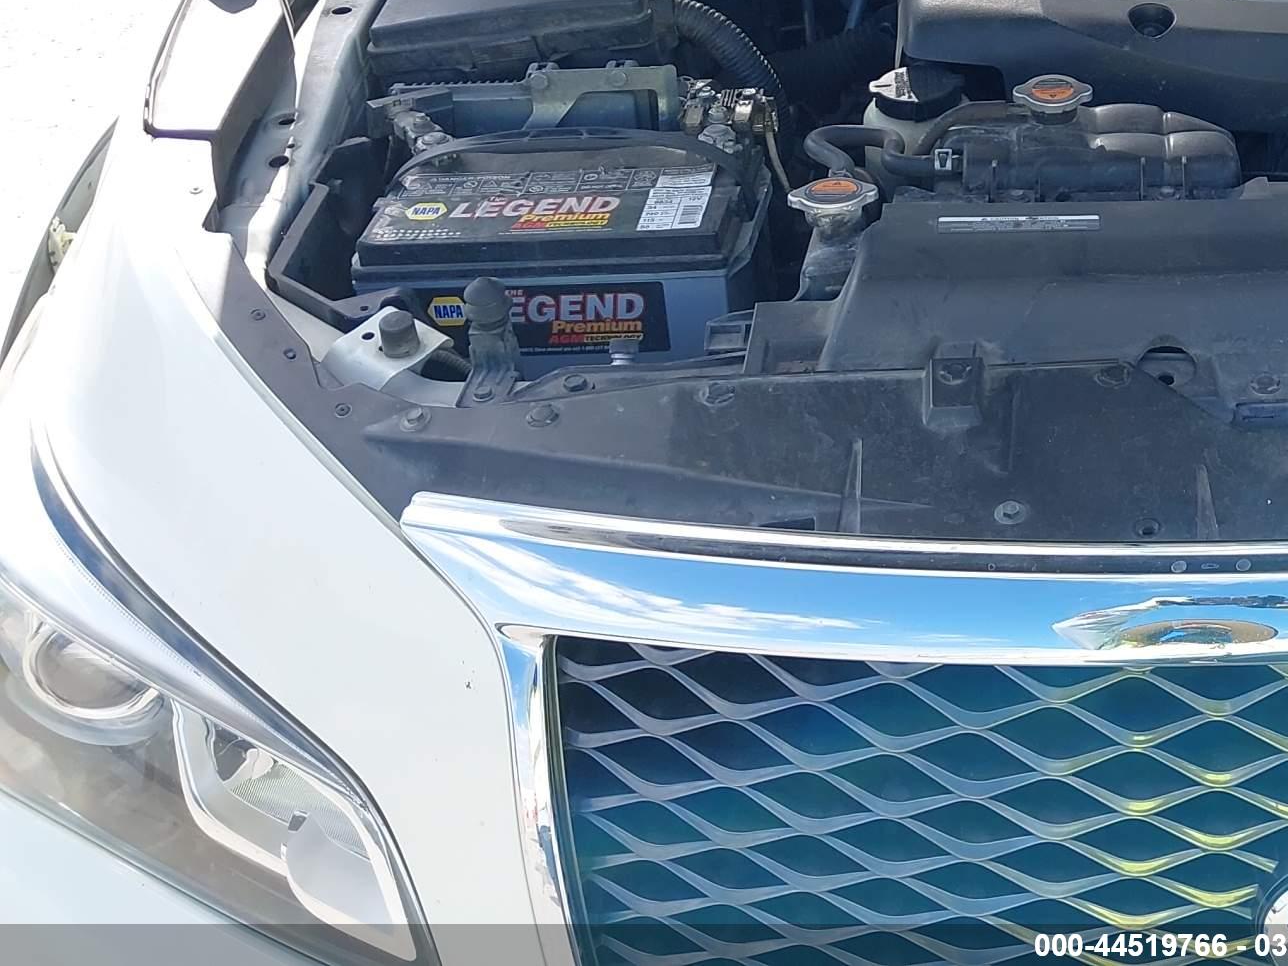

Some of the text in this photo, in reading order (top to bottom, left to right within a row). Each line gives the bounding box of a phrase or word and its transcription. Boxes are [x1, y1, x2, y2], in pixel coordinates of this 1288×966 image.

[411, 206, 441, 216] NAPA
[448, 196, 621, 218] LEGEND
[518, 212, 612, 223] Premium
[433, 304, 464, 320] NAPA
[509, 294, 644, 323] EGEND
[551, 320, 642, 334] Premium
[548, 334, 585, 344] AGM
